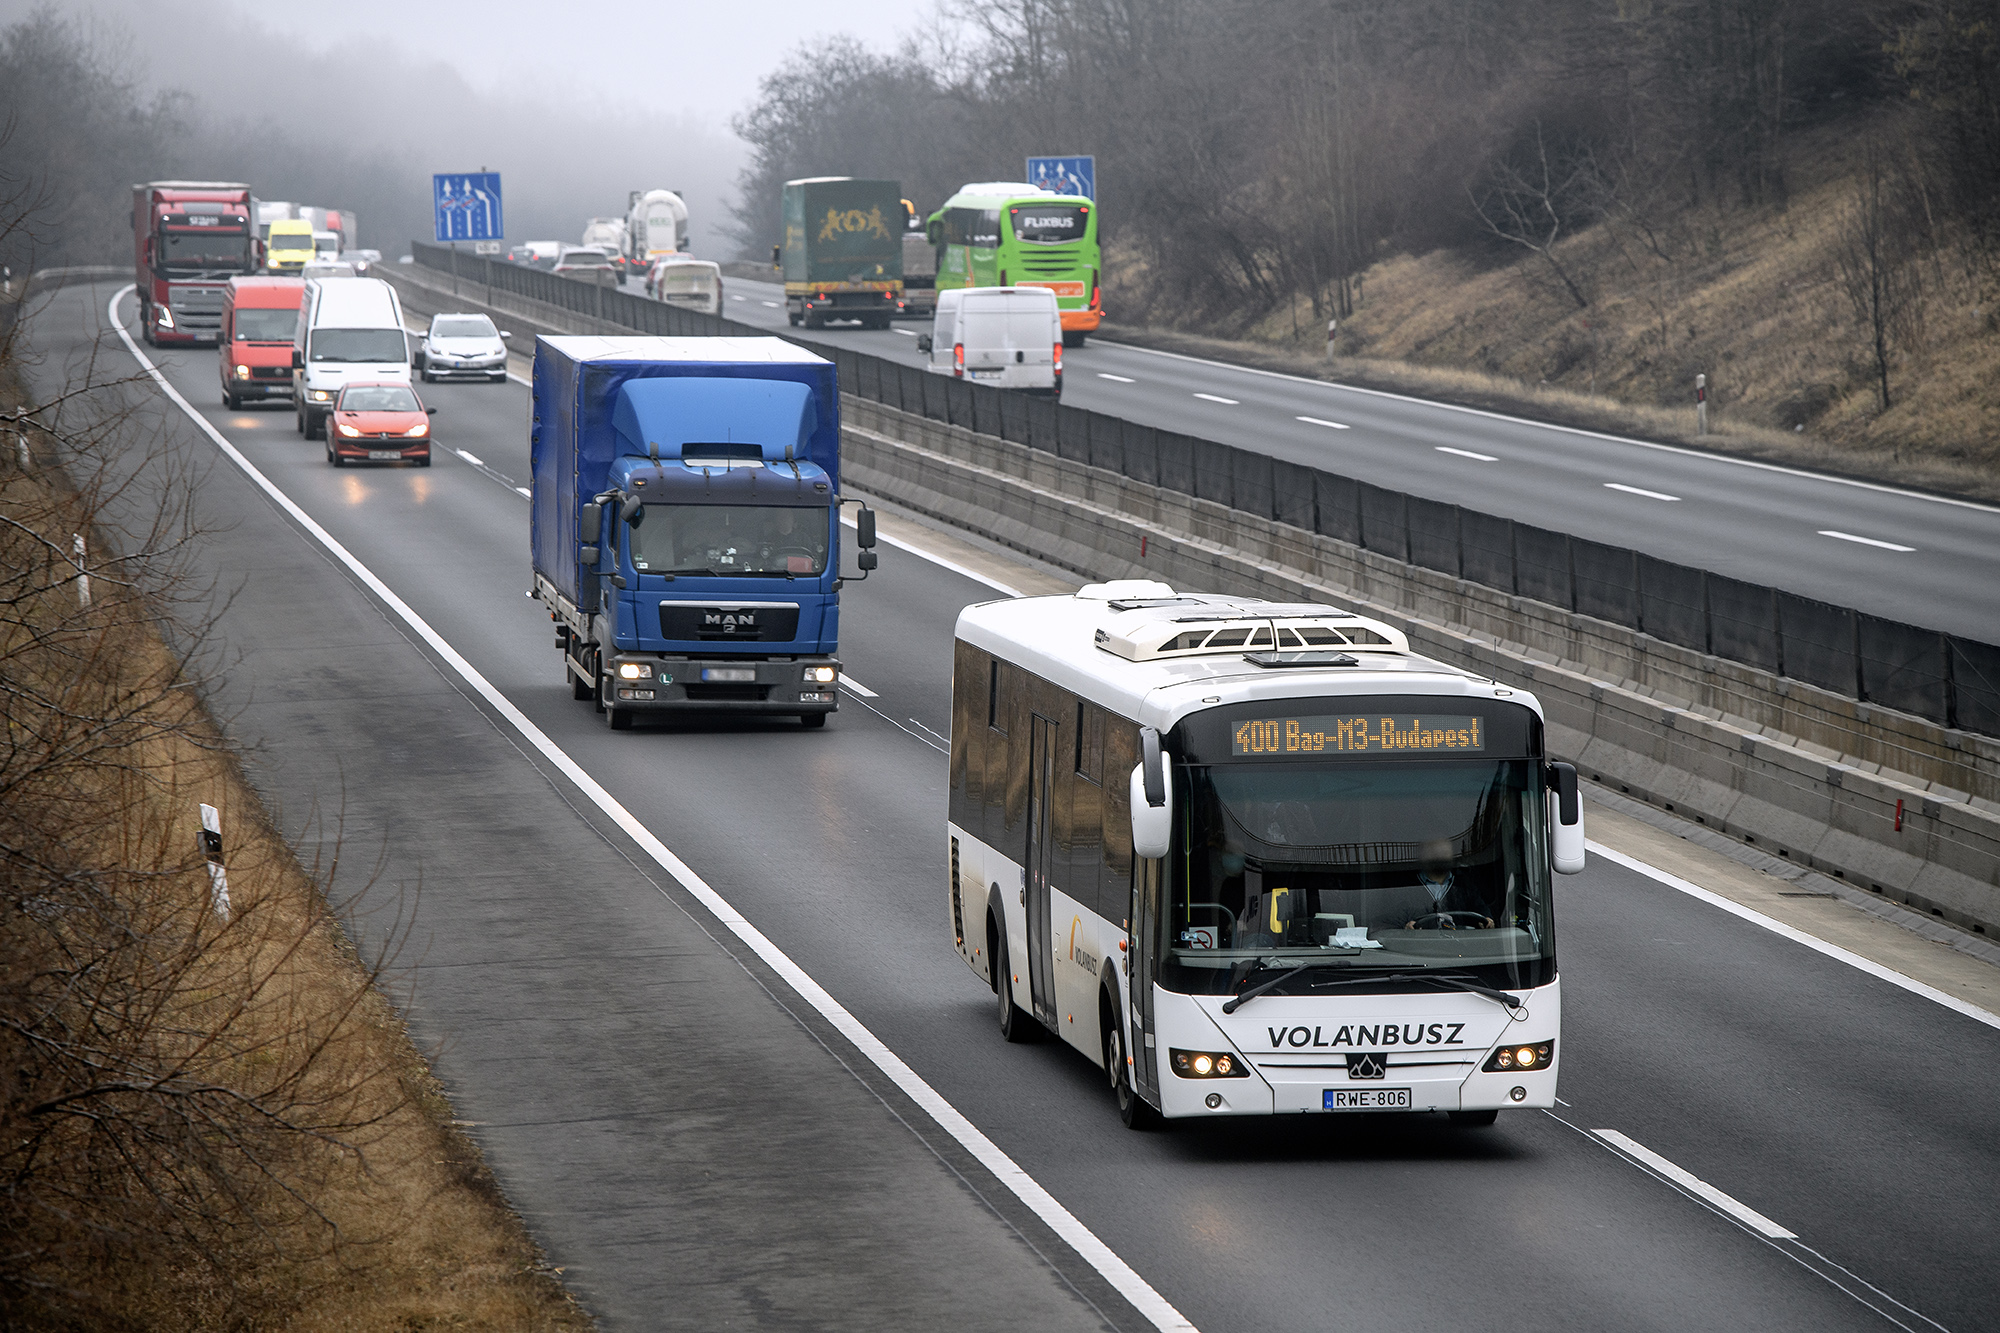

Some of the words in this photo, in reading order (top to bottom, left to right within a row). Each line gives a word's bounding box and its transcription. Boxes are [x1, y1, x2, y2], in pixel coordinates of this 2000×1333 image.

[705, 614, 754, 625] MAN
[662, 674, 671, 684] L
[1236, 720, 1279, 752] 400
[1286, 717, 1480, 752] Bag-M3-Budapest
[1267, 1023, 1466, 1048] VOLÁNBUSZ
[1336, 1091, 1406, 1107] RWE-806
